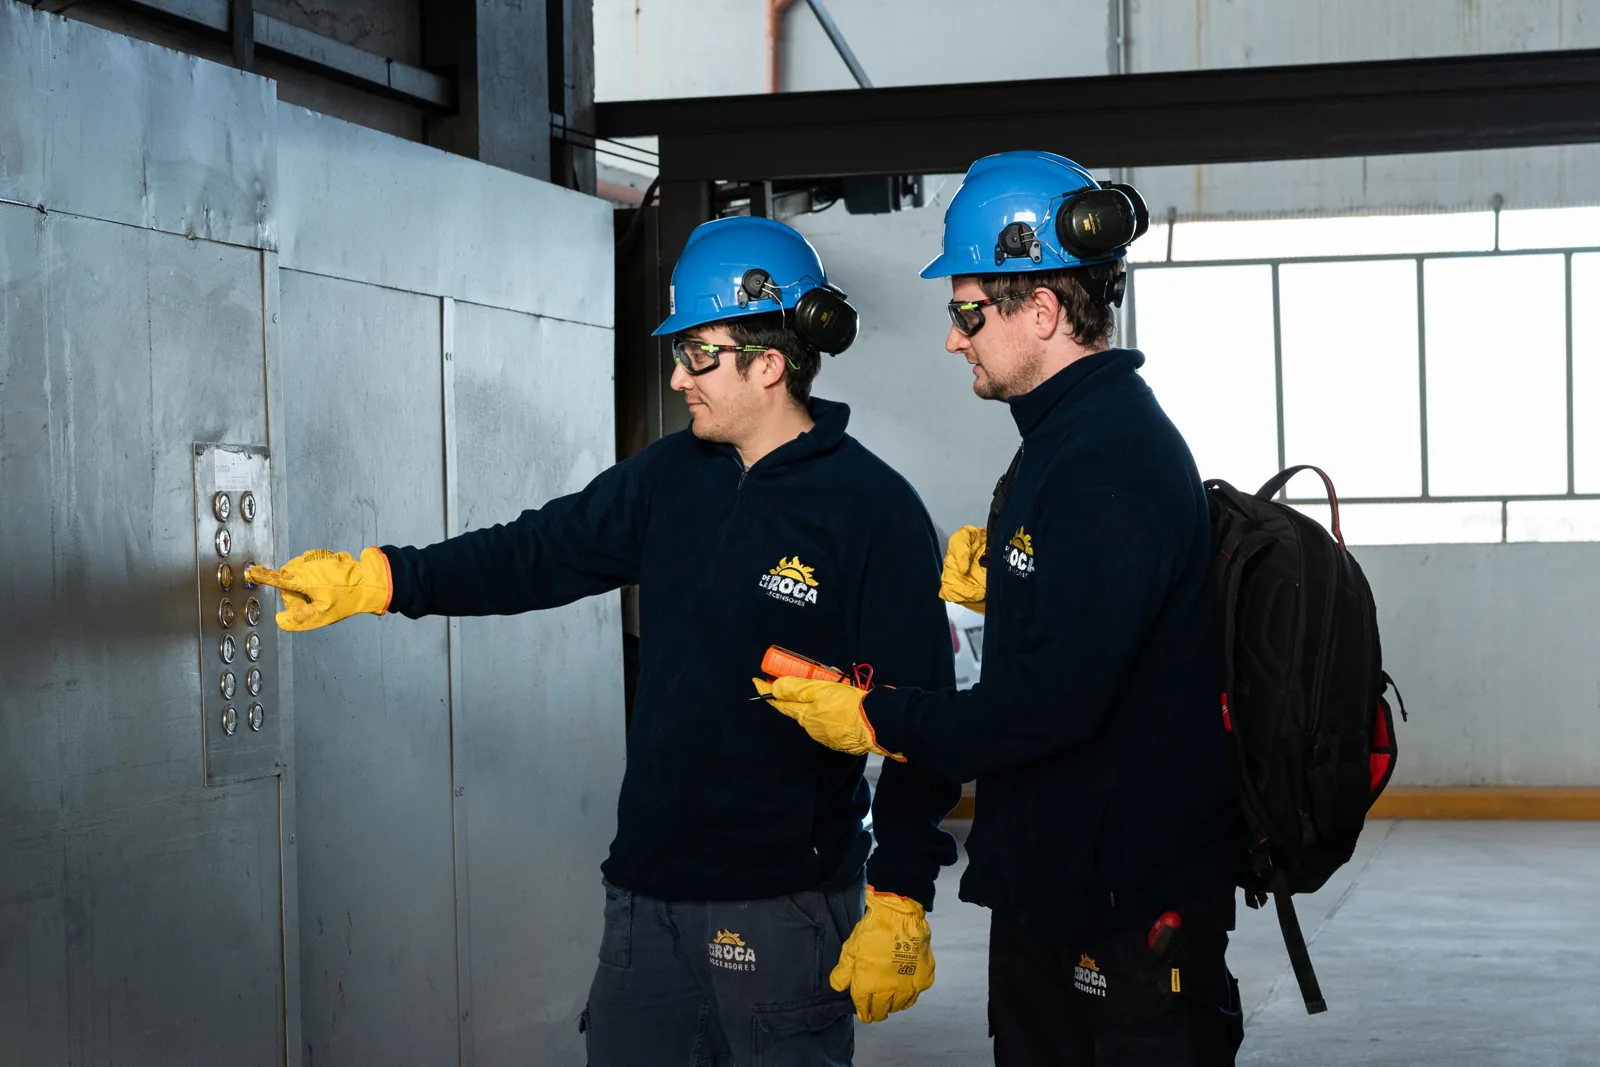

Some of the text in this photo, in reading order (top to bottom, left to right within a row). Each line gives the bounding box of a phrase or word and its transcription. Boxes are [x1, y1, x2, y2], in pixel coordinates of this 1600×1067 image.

[1007, 549, 1035, 572] OCA
[767, 575, 818, 605] ROCA
[714, 943, 756, 962] ROCA
